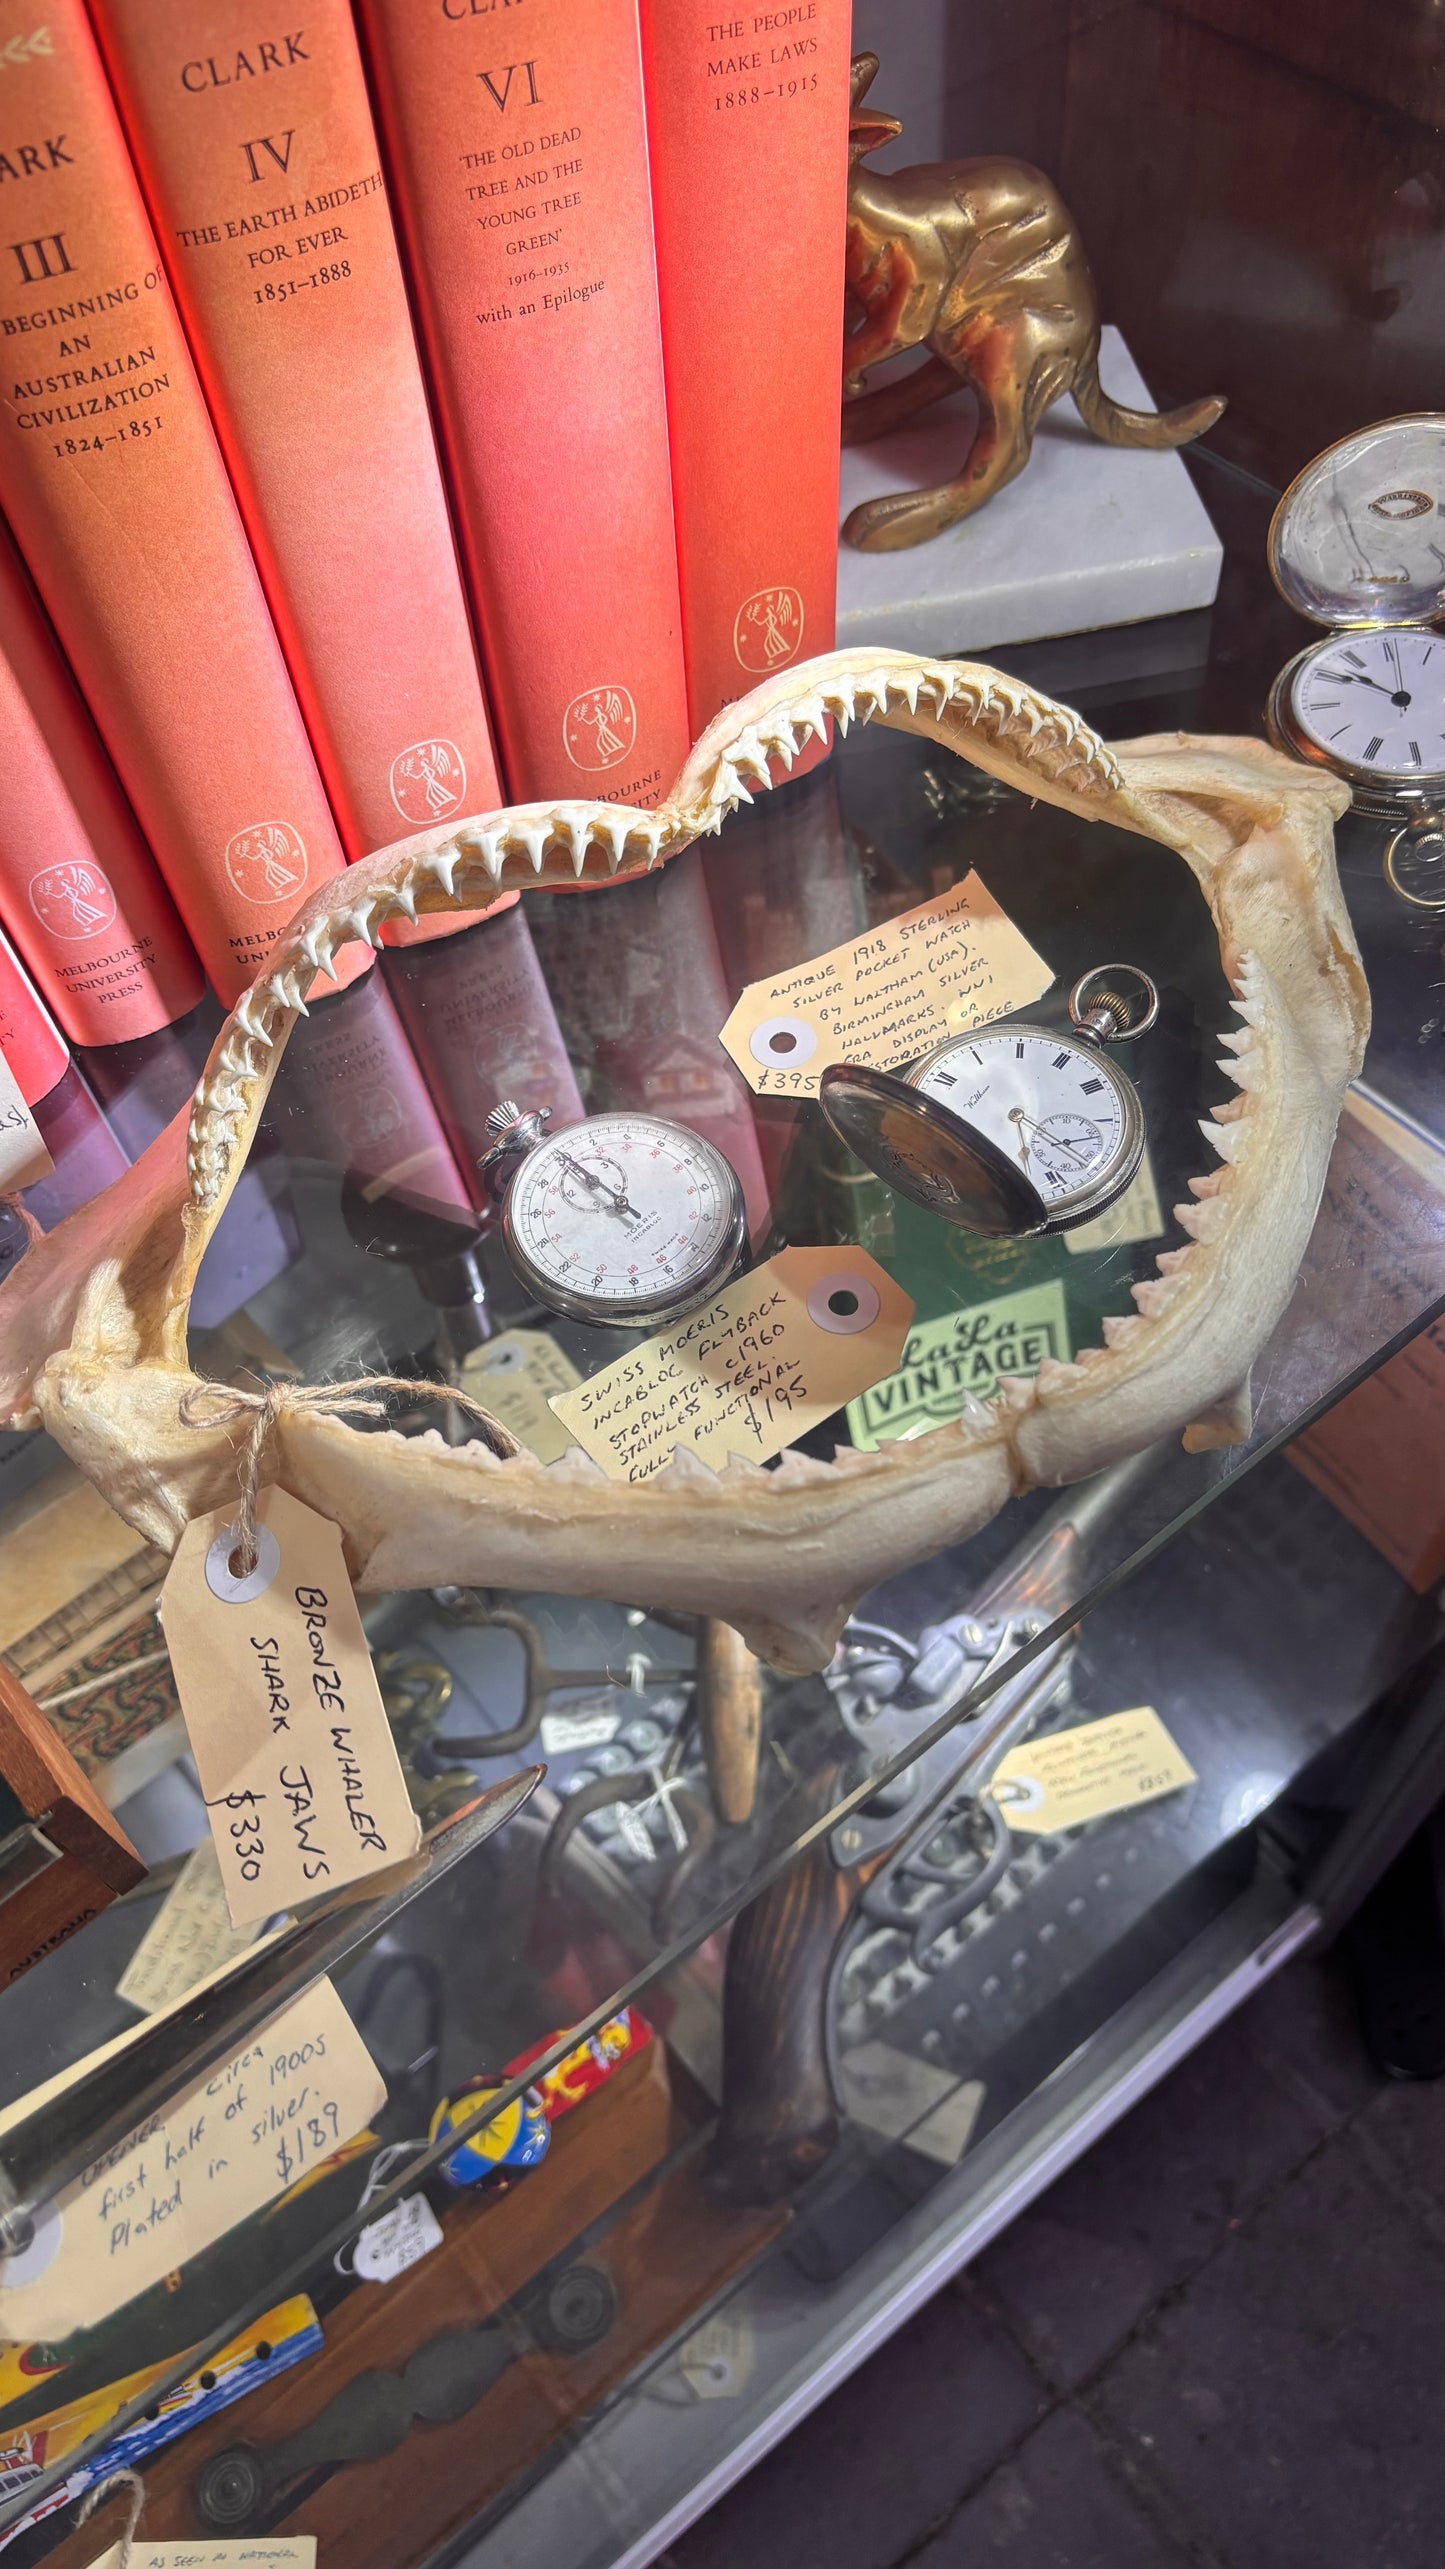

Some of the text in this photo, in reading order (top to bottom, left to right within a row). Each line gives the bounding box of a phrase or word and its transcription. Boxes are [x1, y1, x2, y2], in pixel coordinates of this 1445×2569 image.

[706, 3, 817, 42] THE PEOPLE
[181, 31, 311, 93] CLARK
[706, 37, 818, 77] MAKE LAWS
[476, 60, 543, 113] VI
[714, 74, 819, 111] 1888–1915
[240, 129, 296, 184] IV
[501, 141, 535, 161] OLD
[540, 127, 582, 151] DEAD
[466, 159, 584, 201] TREE AND THE
[176, 171, 385, 248] THE EARTH ABIDETH
[477, 192, 582, 230] YOUNG TREE
[7, 233, 79, 284] III
[247, 226, 348, 269] FOR EVER
[253, 261, 352, 305] 1851–1888
[508, 262, 570, 286] 1916–1935
[1, 264, 163, 336] BEGINNING OF
[476, 279, 605, 325] with an Epilogue
[59, 334, 92, 358] AN
[13, 346, 156, 399] AUSTRALIAN
[16, 374, 170, 430] CIVILIZATION
[53, 416, 163, 458] 1824–1851
[596, 770, 661, 802] BOURNE
[54, 937, 152, 977] MELBOURNE
[770, 898, 970, 999] ANTIQUE 1918 STERLING
[793, 920, 971, 1008] SILVER POCKET WATCH
[66, 954, 156, 993] UNIVERSITY
[97, 981, 143, 1004] PRESS
[820, 1007, 841, 1020] BY
[854, 971, 923, 1006] WALTHAM
[833, 958, 989, 1035] BIRMINGHAM SILVER
[868, 1001, 1014, 1072] STORATION PIECE
[892, 1019, 948, 1048] DISPLAY
[960, 1003, 978, 1018] OR
[757, 1069, 820, 1090] $395
[537, 1179, 549, 1189] 28
[684, 1158, 692, 1166] 8
[566, 1189, 576, 1198] 12
[613, 1183, 621, 1191] 6
[699, 1183, 710, 1192] 10
[530, 1208, 542, 1219] 26
[624, 1211, 657, 1239] MOERIS
[559, 1261, 571, 1272] 22
[591, 1275, 603, 1287] 20
[628, 1276, 639, 1287] 18
[662, 1265, 674, 1275] 16
[581, 1361, 644, 1412] SWISS
[660, 1304, 729, 1361] MOERIS
[594, 1363, 683, 1429] INCABLOC
[698, 1292, 786, 1360] FLYBACK
[872, 1337, 1042, 1412] VINTAGE
[609, 1374, 709, 1450] STOPWATCH
[694, 1360, 800, 1440] FUNCTIONAL
[744, 1375, 807, 1443] $195
[619, 1398, 700, 1465] STAINLESS
[295, 1586, 387, 1852] BRONZE WHALER
[250, 1636, 330, 1881] SHARK JAWS
[204, 1789, 267, 1882] $330
[206, 2046, 264, 2095] circa
[99, 2162, 147, 2220] first
[165, 2115, 205, 2170] half
[224, 2083, 248, 2121] of
[276, 2101, 339, 2184] $189
[209, 2159, 228, 2179] in
